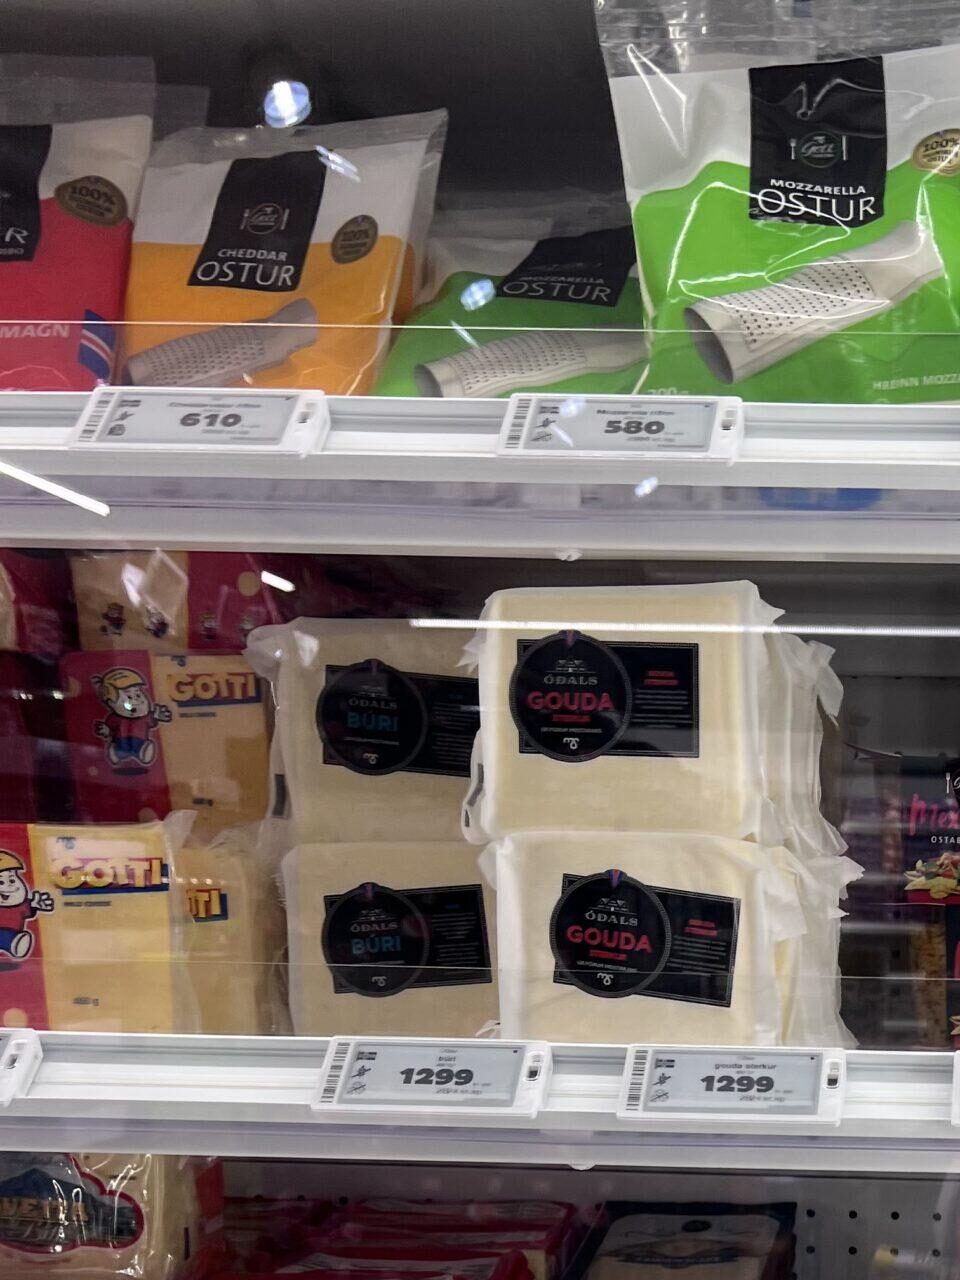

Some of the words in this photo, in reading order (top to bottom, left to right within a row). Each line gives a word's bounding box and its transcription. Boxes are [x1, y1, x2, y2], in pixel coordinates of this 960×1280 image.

[769, 178, 867, 196] MOZZARELLA
[757, 188, 877, 222] OSTUR
[217, 248, 288, 262] CHEDDAR
[196, 261, 295, 287] OSTUR
[503, 280, 612, 302] OSTUR
[180, 413, 242, 428] 610
[604, 420, 665, 434] 580
[544, 673, 599, 686] ÓDALS
[527, 690, 615, 712] GOUDA
[347, 710, 399, 733] BÚRI
[584, 911, 639, 927] ÓDALS
[351, 933, 401, 955] BÚRI
[566, 924, 653, 954] GOUDA
[400, 1068, 474, 1086] 1299
[701, 1075, 775, 1093] 1299
